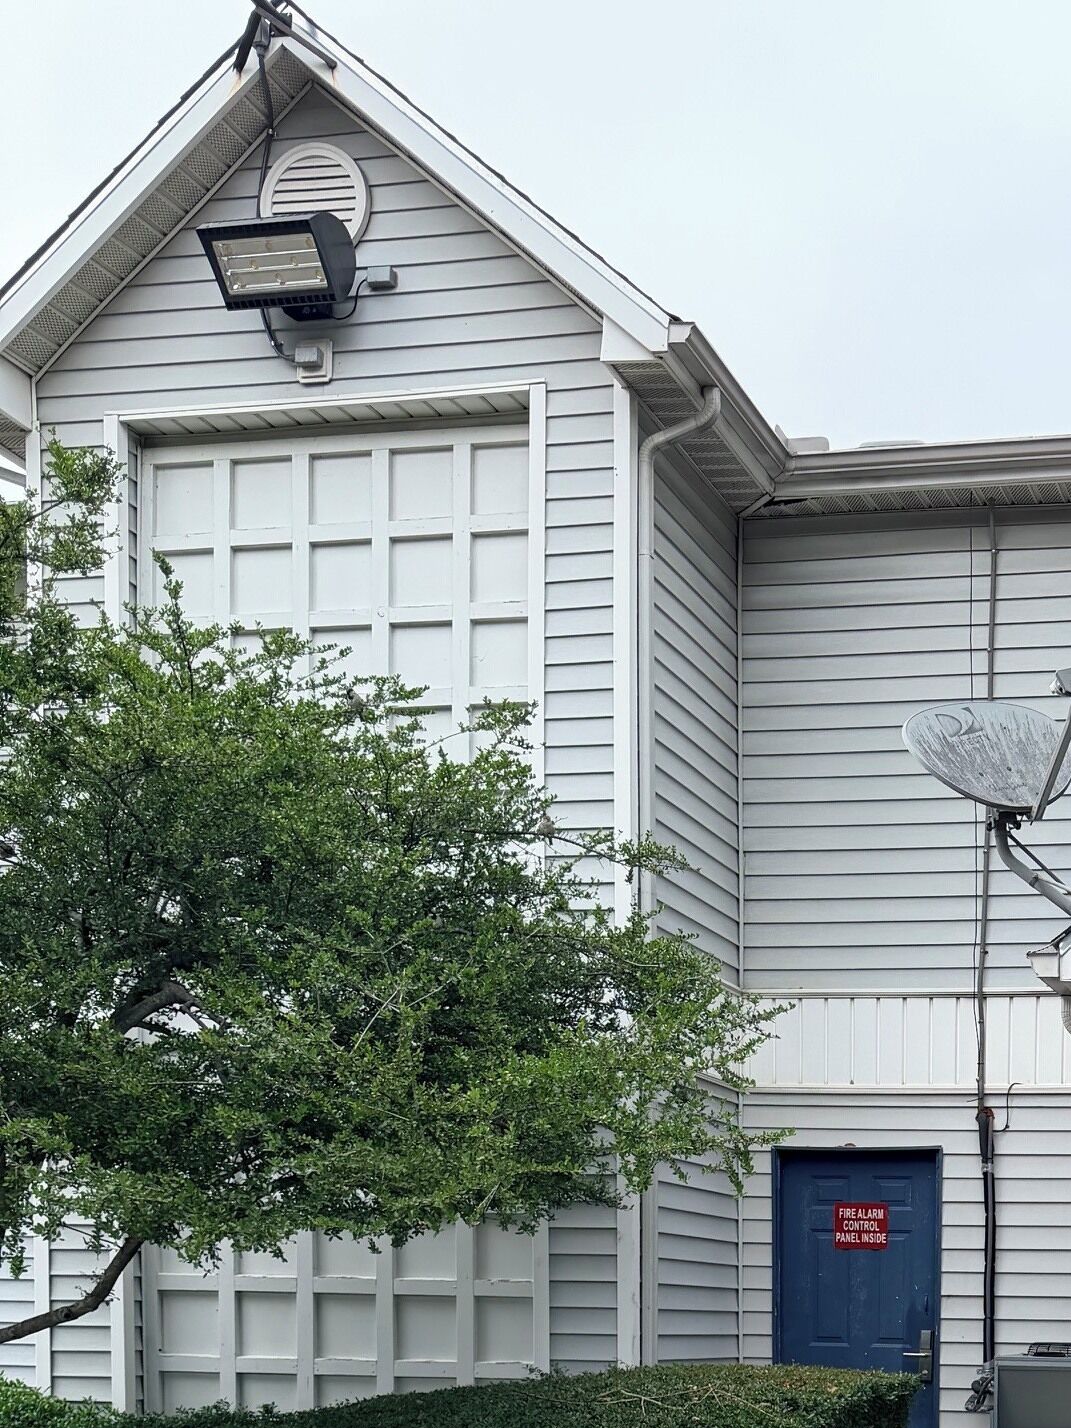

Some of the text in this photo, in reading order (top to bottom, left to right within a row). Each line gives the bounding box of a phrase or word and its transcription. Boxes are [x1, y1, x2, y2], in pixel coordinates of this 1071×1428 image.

[839, 1208, 884, 1220] FIRE ALARM
[843, 1220, 880, 1231] CONTROL
[835, 1232, 887, 1243] PANEL INSIDE
